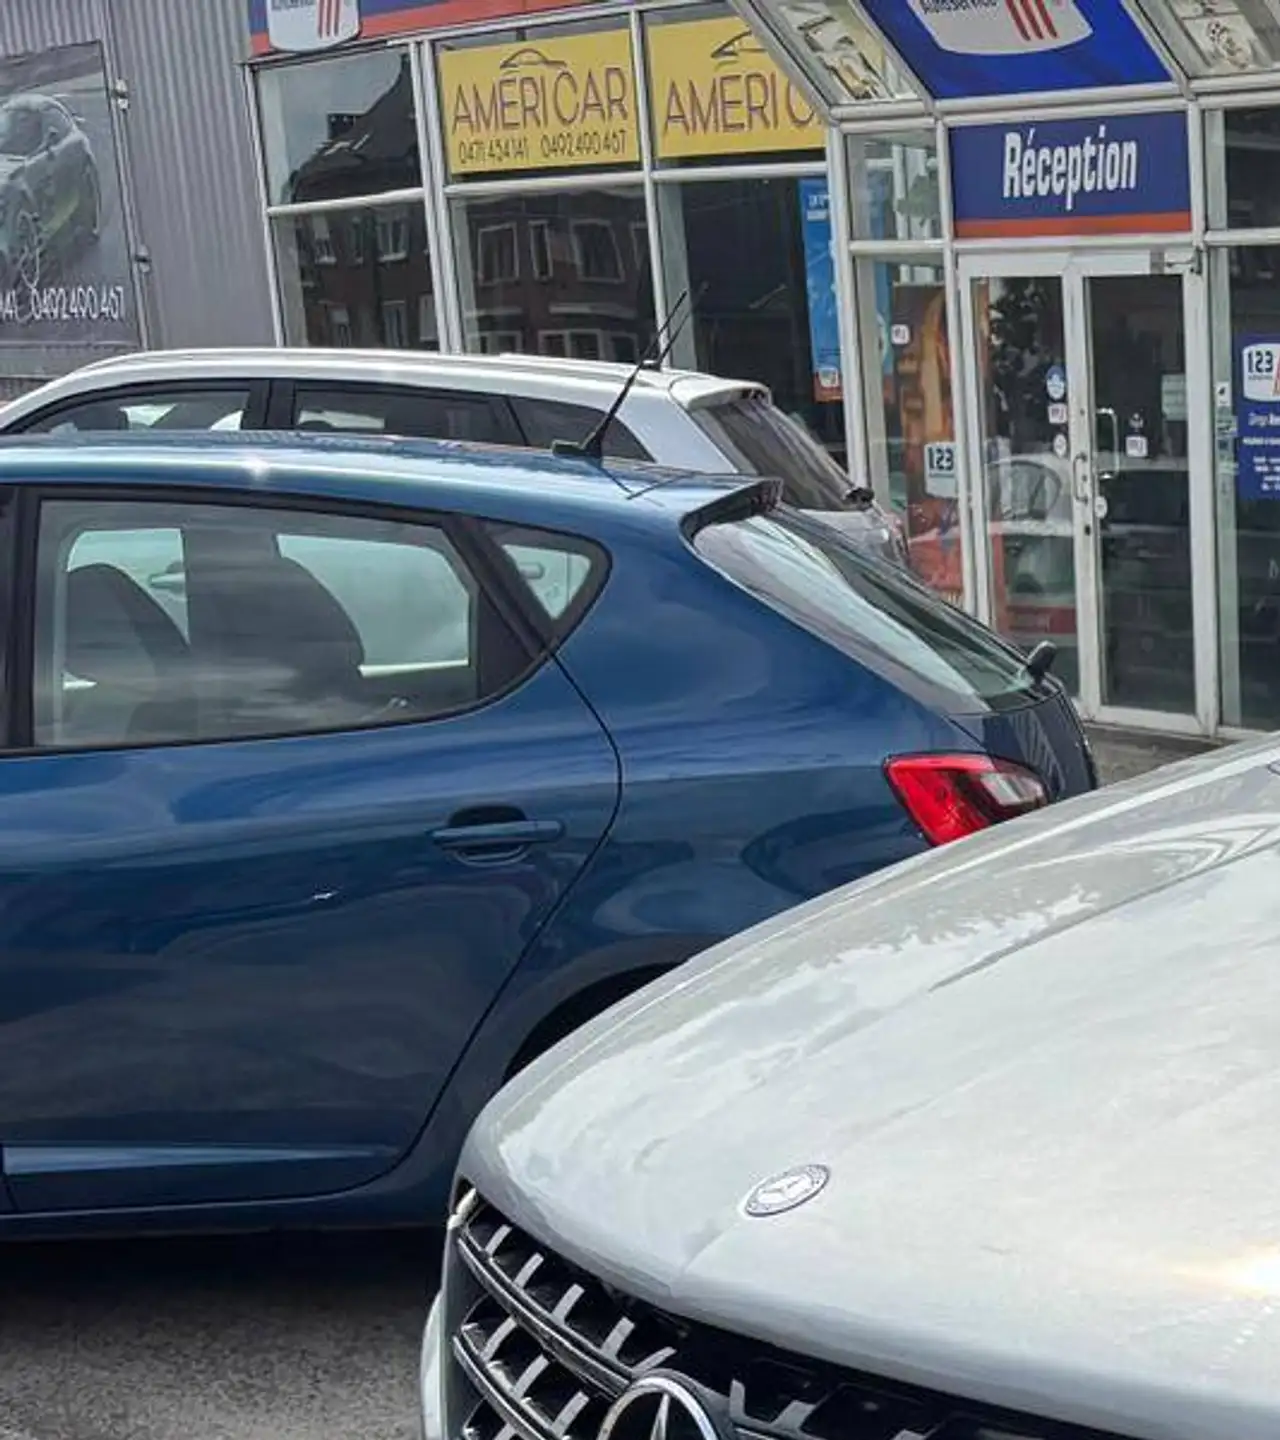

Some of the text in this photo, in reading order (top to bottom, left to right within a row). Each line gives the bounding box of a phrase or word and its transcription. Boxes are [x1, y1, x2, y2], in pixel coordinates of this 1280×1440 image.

[1003, 125, 1137, 211] Réception
[1247, 349, 1274, 374] 123
[928, 447, 955, 472] 123
